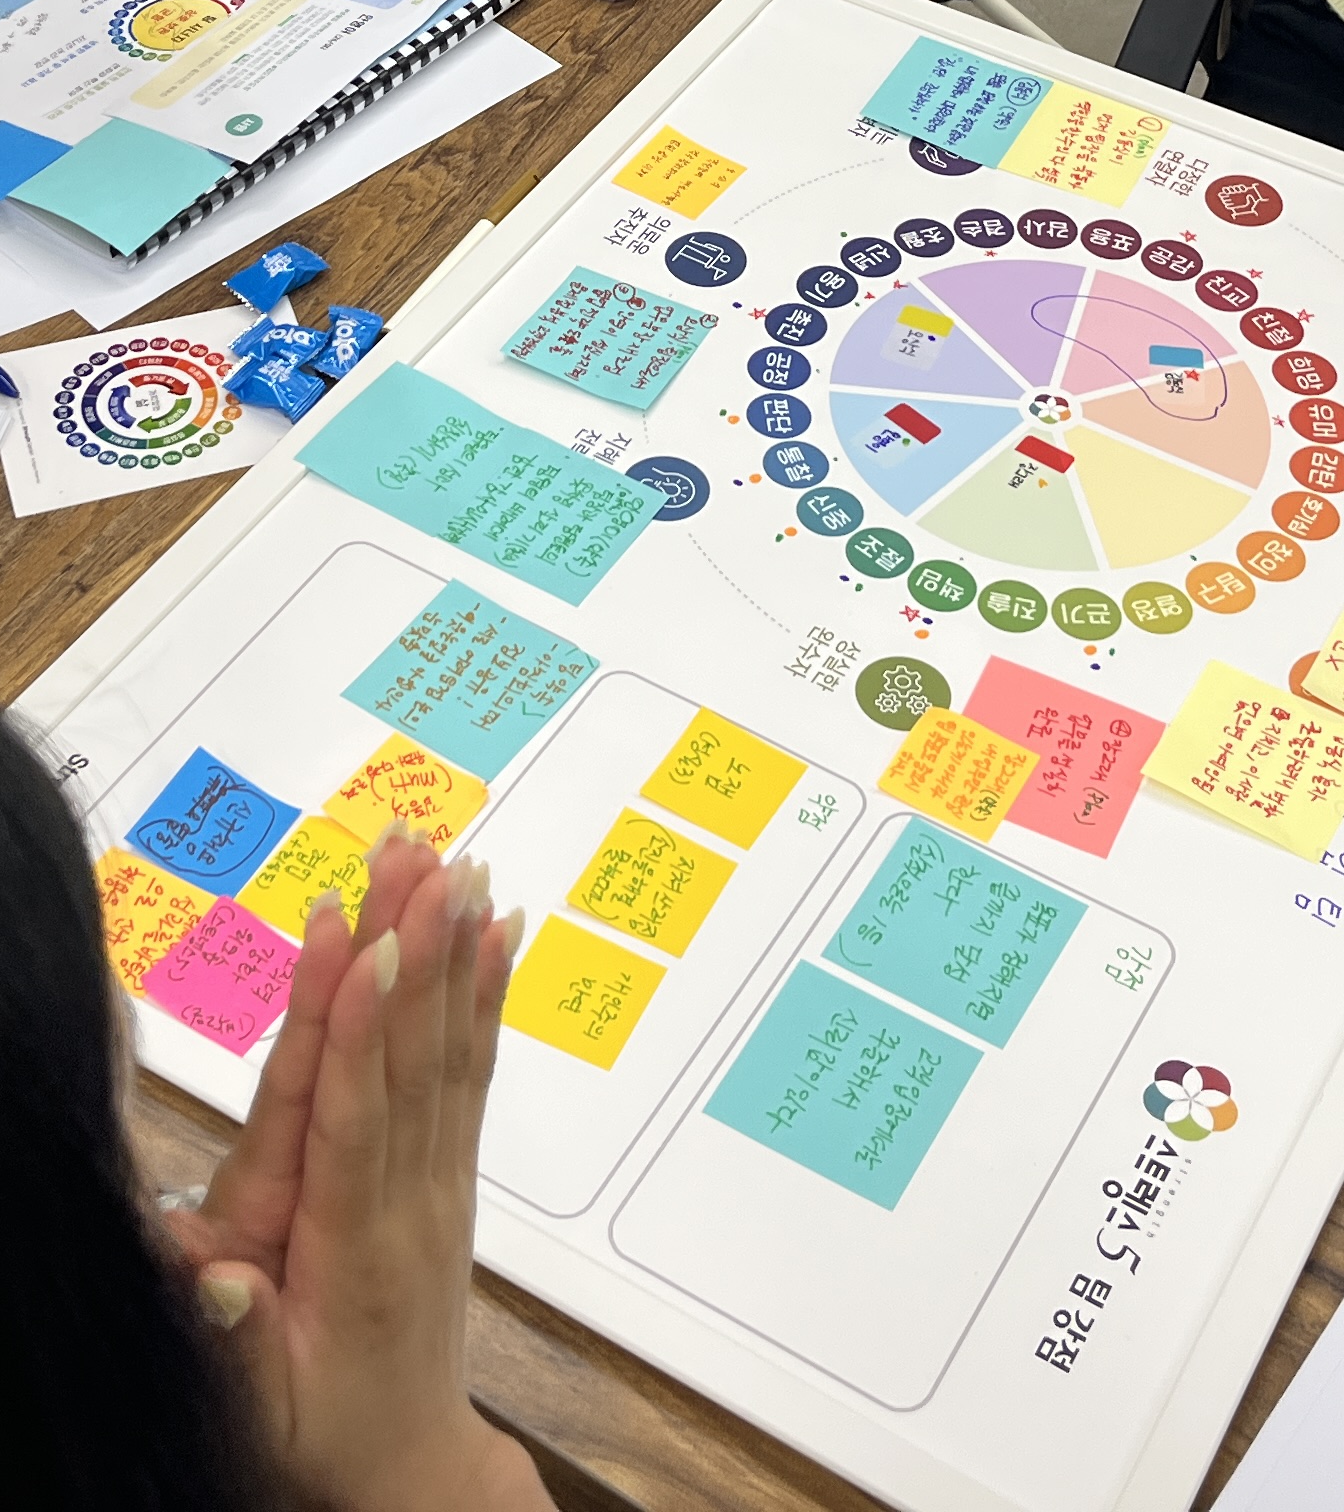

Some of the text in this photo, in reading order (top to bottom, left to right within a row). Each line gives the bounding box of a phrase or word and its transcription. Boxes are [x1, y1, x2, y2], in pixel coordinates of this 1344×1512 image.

[1144, 149, 1185, 187] 연결자
[1168, 158, 1210, 197] 다정한
[603, 206, 649, 246] 추진자
[625, 215, 672, 255] 의로운
[899, 226, 945, 250] 초월
[960, 218, 1006, 238] 겸손
[1023, 218, 1069, 239] 감사
[1089, 227, 1135, 252] 포용
[847, 243, 891, 272] 신념
[1148, 245, 1196, 275] 공감
[804, 271, 846, 303] 용기
[1204, 275, 1251, 308] 친교
[776, 309, 813, 342] 촉진
[898, 325, 931, 358] 오상식
[1251, 311, 1294, 346] 친절
[762, 352, 792, 386] 공정
[1286, 356, 1325, 390] 희망
[763, 398, 794, 434] 판단
[1307, 403, 1338, 438] 유머
[592, 432, 633, 466] 지혜
[864, 429, 902, 454] 안영이
[776, 446, 815, 483] 통찰
[1007, 462, 1039, 489] 장그래
[1308, 451, 1339, 489] 감탄
[806, 495, 852, 531] 신중
[1287, 495, 1324, 537] 호기심
[853, 534, 905, 572] 조절
[1247, 539, 1294, 576] 창의
[915, 568, 965, 602] 책임
[1197, 571, 1247, 605] 탐구
[986, 591, 1037, 621] 진솔
[1060, 602, 1112, 625] 끈기
[1130, 594, 1183, 622] 열정
[783, 625, 835, 679] 완수자
[810, 640, 862, 693] 성실한
[397, 700, 434, 732] 논의
[1026, 706, 1060, 739] 완료
[1036, 713, 1093, 798] 업무를 성실히
[797, 793, 840, 833] 약점
[933, 864, 982, 917] 한다
[943, 882, 1021, 984] 끝까지 달성
[231, 948, 276, 985] 강화
[965, 900, 1059, 1021] 목표가 정해지면
[1104, 946, 1153, 992] 강점
[557, 977, 597, 1014] 만연
[582, 971, 633, 1041] 개인주의
[831, 1028, 901, 1111] 꾸준해서
[1034, 1134, 1181, 1374] 스트렝스5 팀 강점
